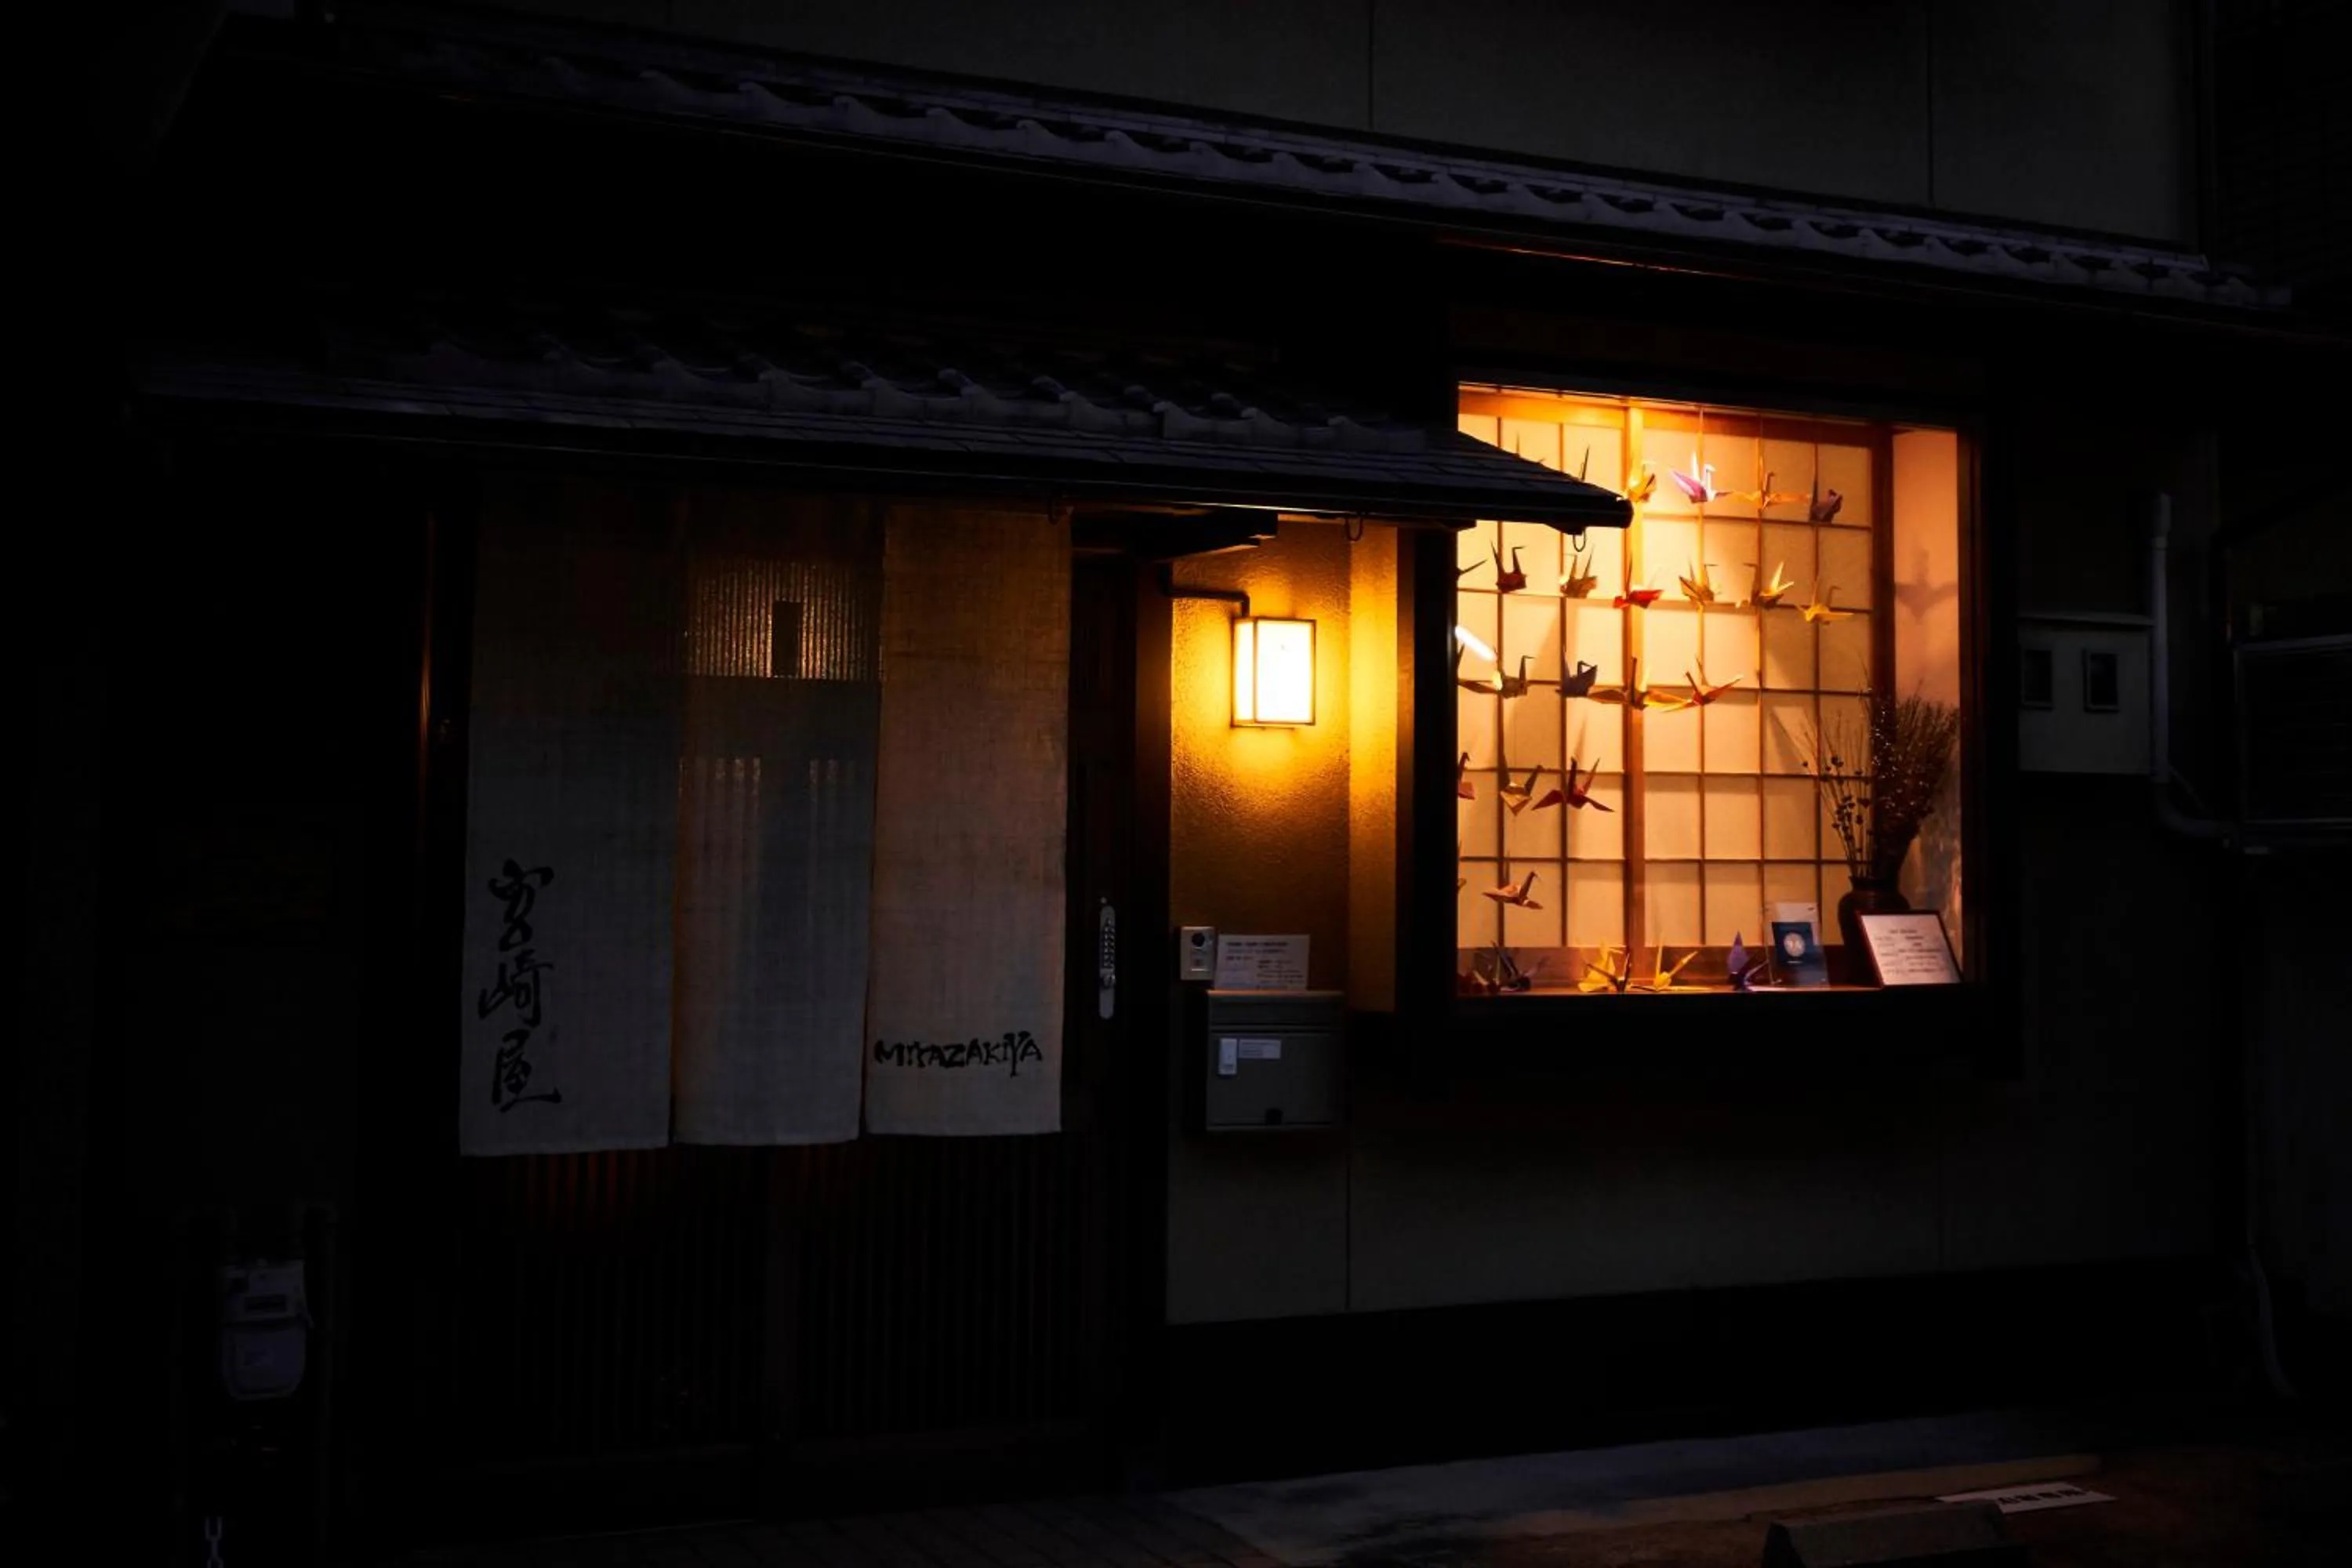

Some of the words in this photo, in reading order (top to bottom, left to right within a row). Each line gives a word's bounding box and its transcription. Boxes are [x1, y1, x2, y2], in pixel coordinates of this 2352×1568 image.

[478, 858, 561, 1112] 宮崎屋
[874, 1030, 1043, 1077] MIYAZAKIYA
